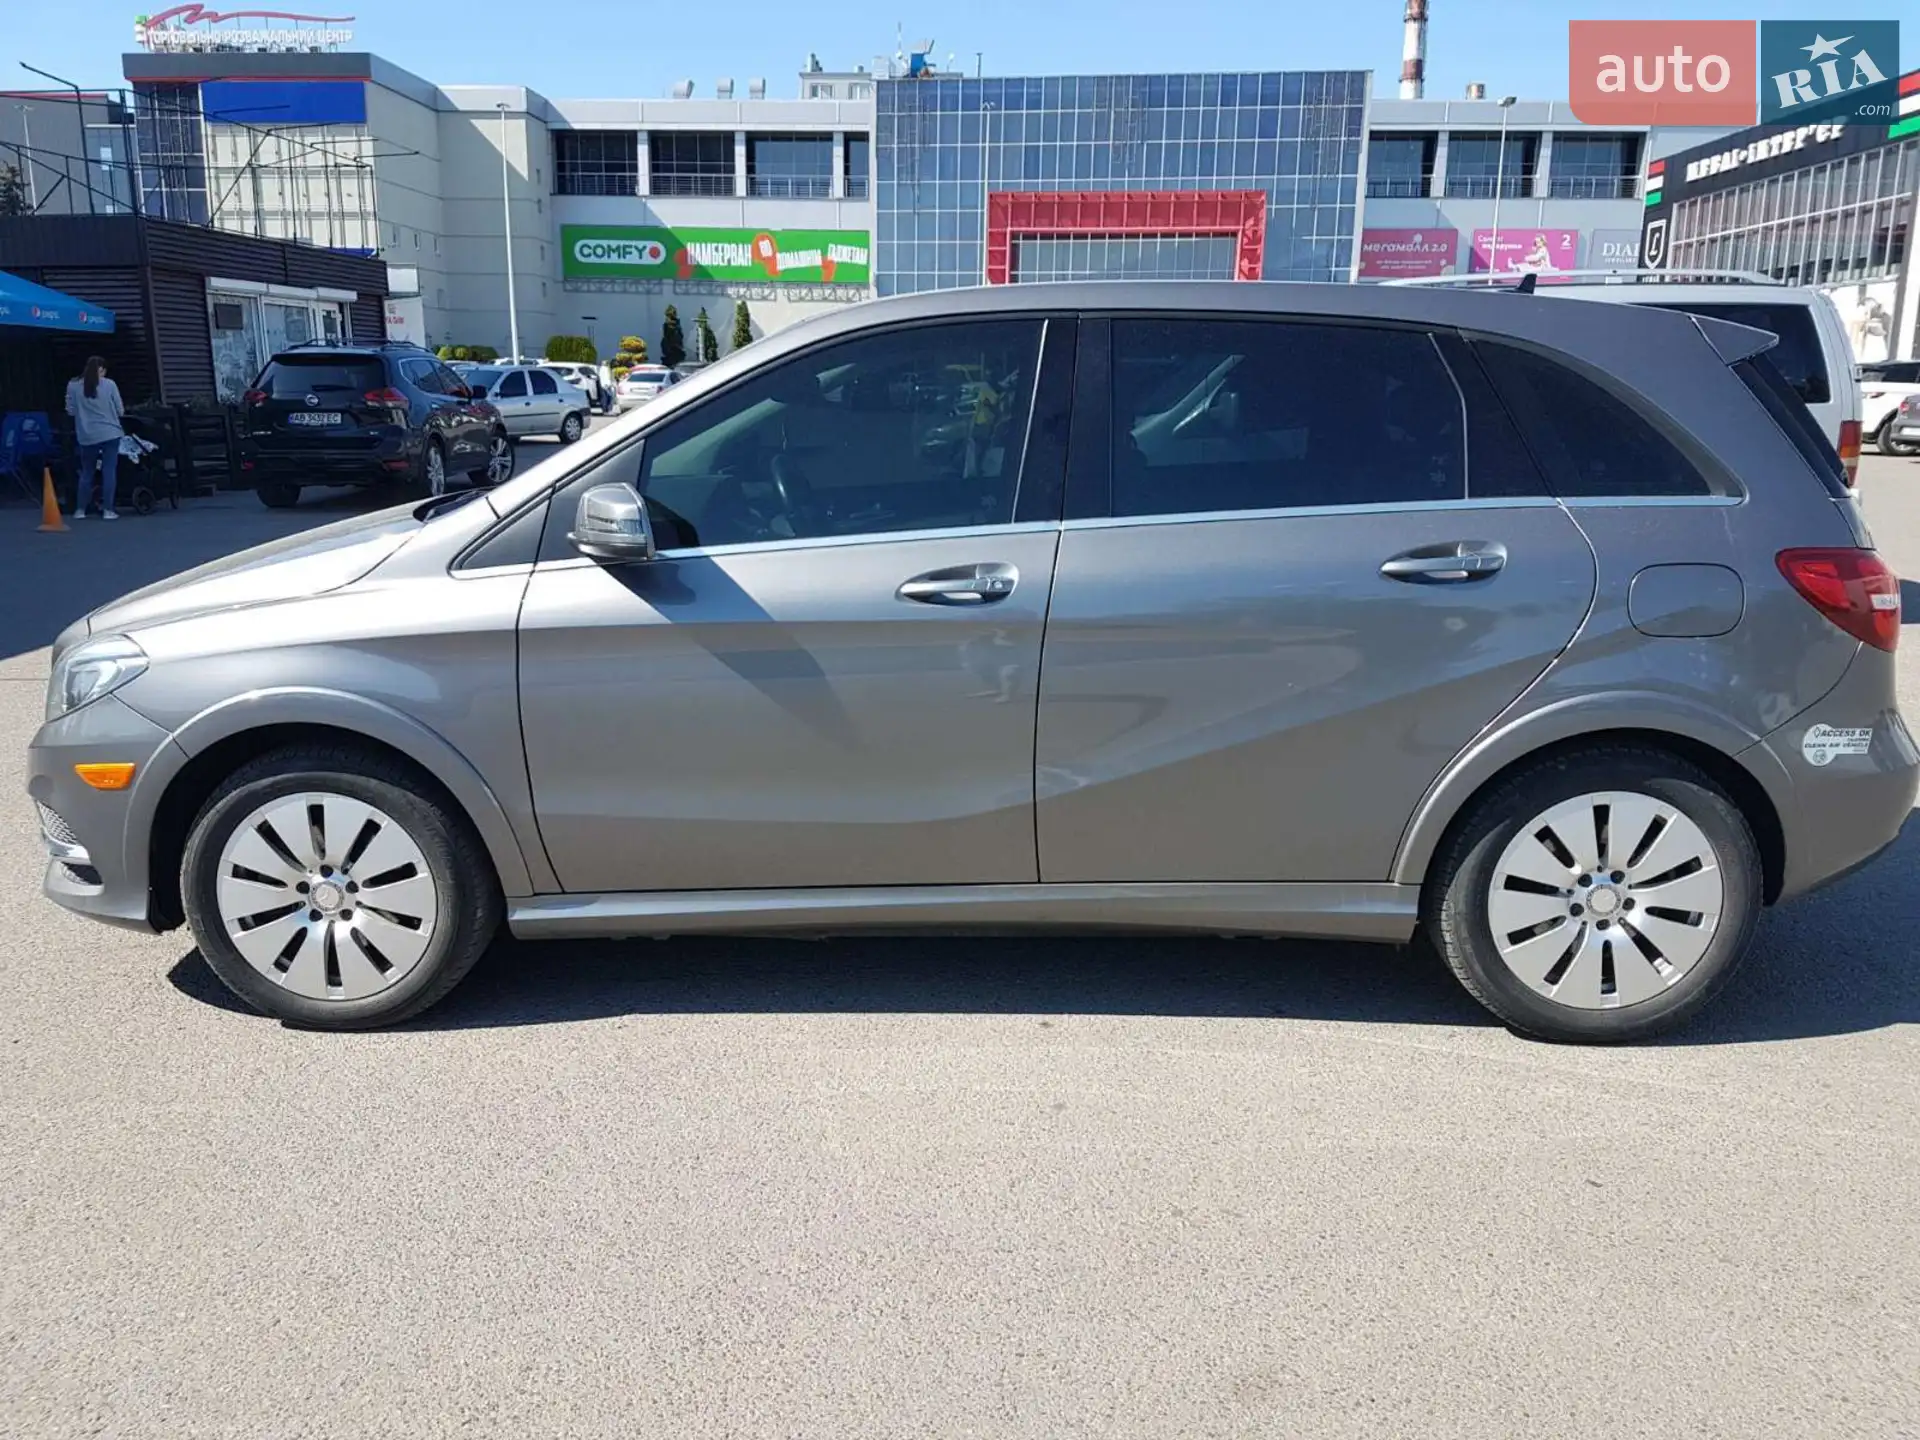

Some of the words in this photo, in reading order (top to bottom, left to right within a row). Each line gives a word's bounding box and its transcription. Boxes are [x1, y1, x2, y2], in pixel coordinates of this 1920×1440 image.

[318, 30, 354, 43] ЦЕНТР
[580, 244, 647, 259] COMFY
[686, 242, 752, 266] НАМБЕРВАН
[1820, 729, 1856, 737] ACCESS
